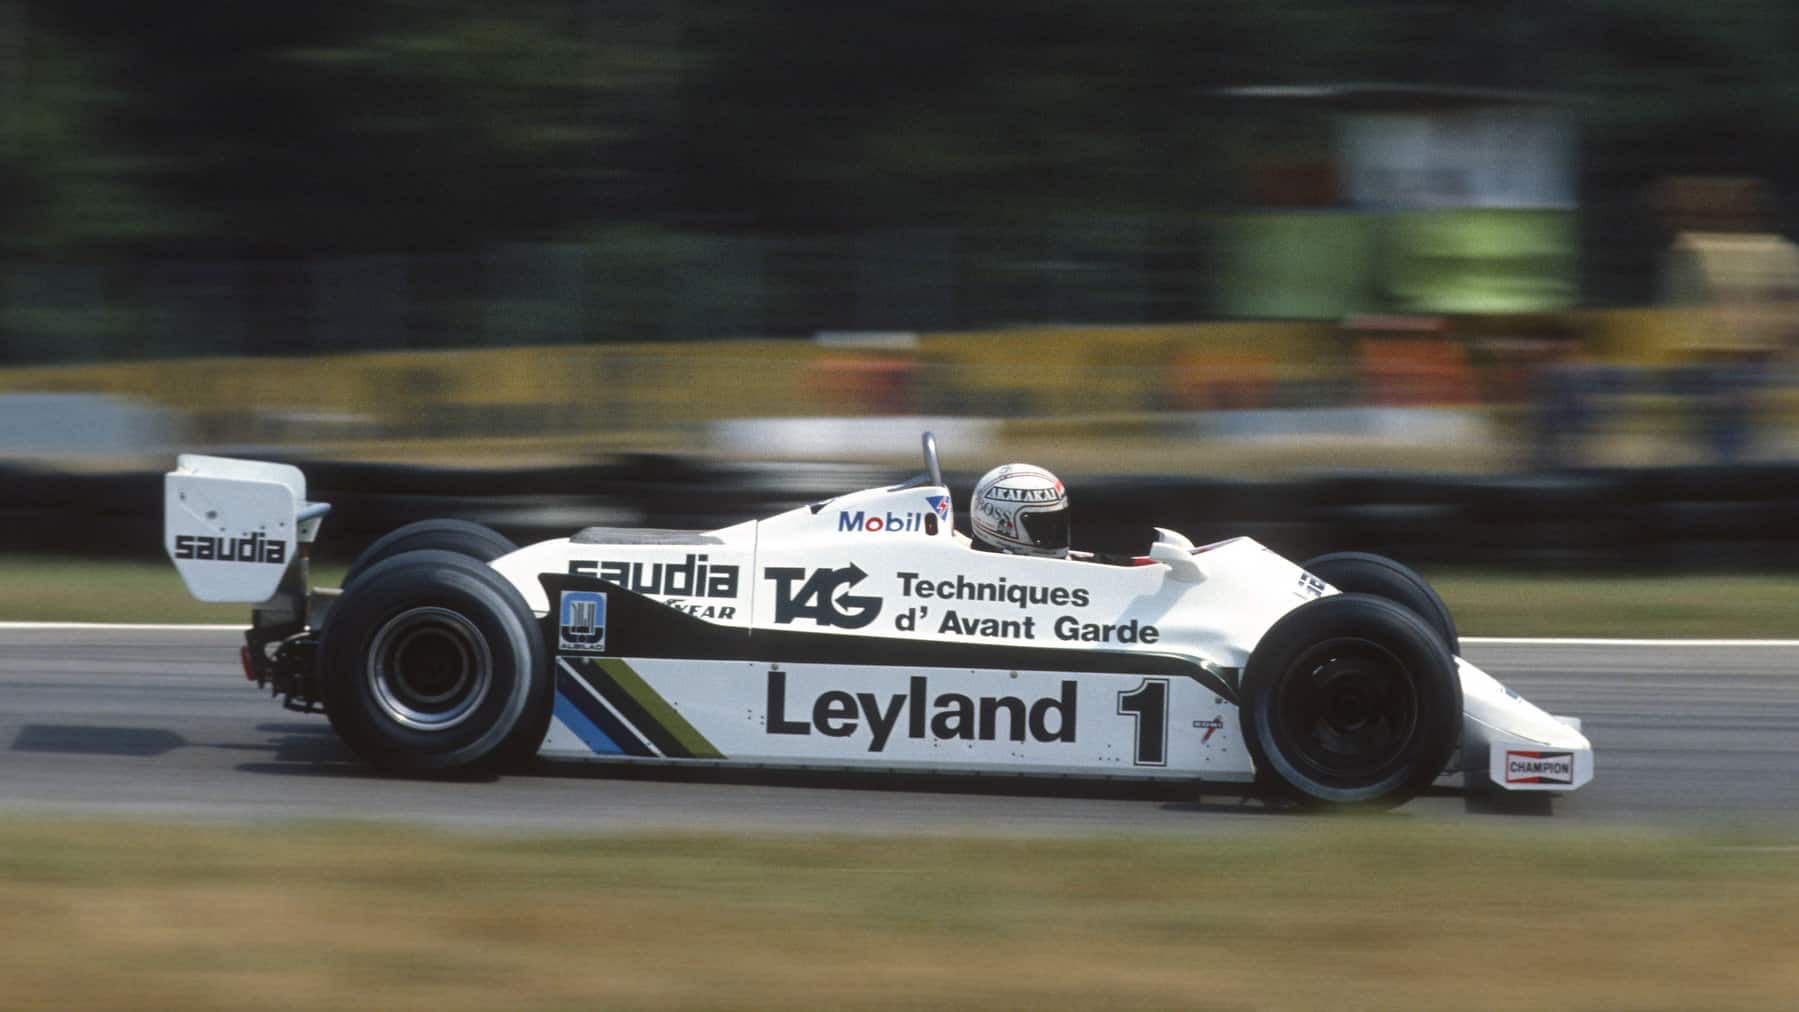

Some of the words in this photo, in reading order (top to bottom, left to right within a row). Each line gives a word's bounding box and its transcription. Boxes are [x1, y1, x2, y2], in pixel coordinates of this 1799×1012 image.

[989, 488, 1022, 501] AKAI
[838, 510, 922, 532] Mobil
[174, 532, 286, 564] saudia
[764, 561, 883, 629] TAG
[896, 572, 1090, 608] Techniques
[938, 609, 1035, 640] Avant
[1054, 615, 1160, 644] Garde
[765, 671, 1078, 752] Leyland
[1117, 677, 1170, 767] 1
[1509, 761, 1569, 774] CHAMPION
